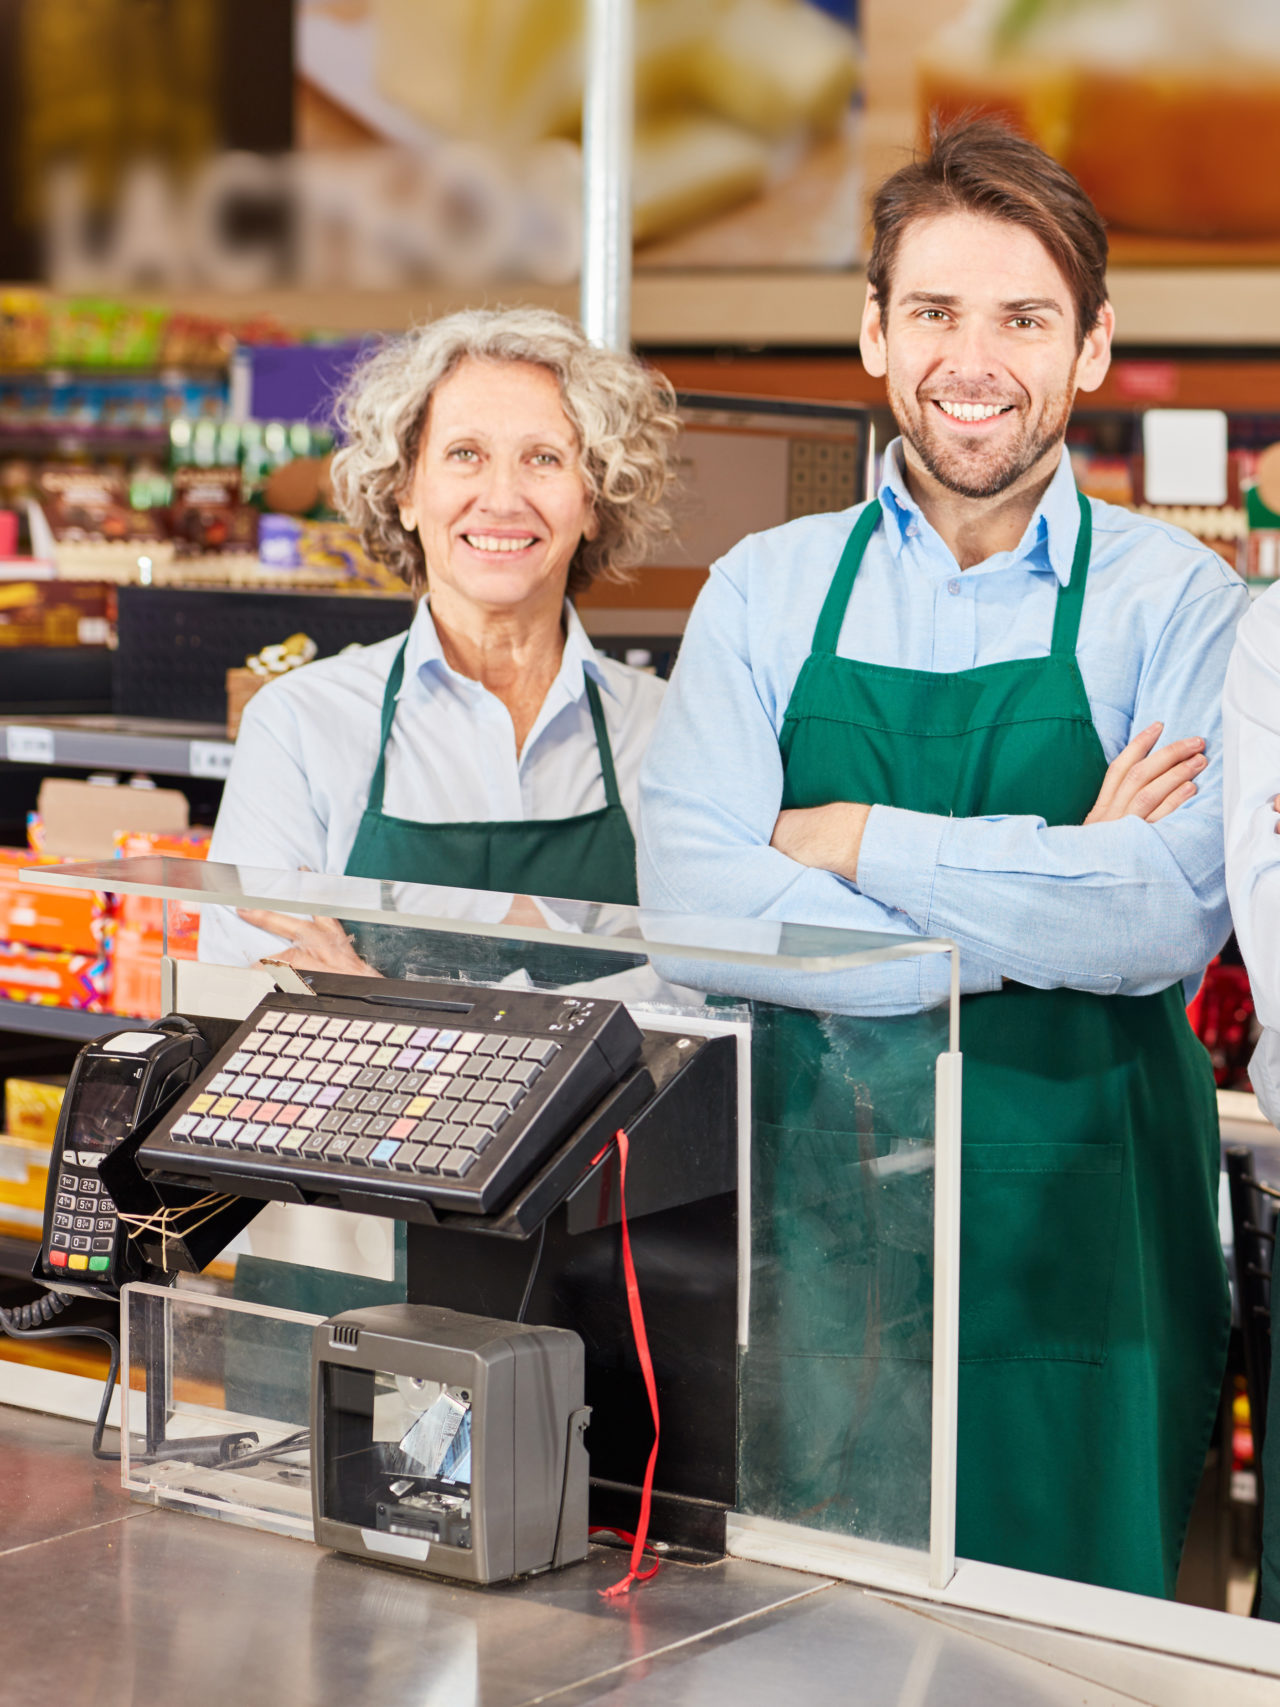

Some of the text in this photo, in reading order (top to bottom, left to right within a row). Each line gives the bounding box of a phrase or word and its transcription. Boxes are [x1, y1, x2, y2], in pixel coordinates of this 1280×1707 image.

[363, 1072, 374, 1081] 7
[385, 1075, 396, 1084] 8
[407, 1077, 418, 1087] 9
[348, 1094, 355, 1103] 4
[369, 1096, 379, 1106] 5
[391, 1099, 402, 1109] 6
[331, 1116, 338, 1125] 1
[351, 1118, 362, 1128] 2
[375, 1120, 386, 1130] 3
[312, 1137, 322, 1146] 0
